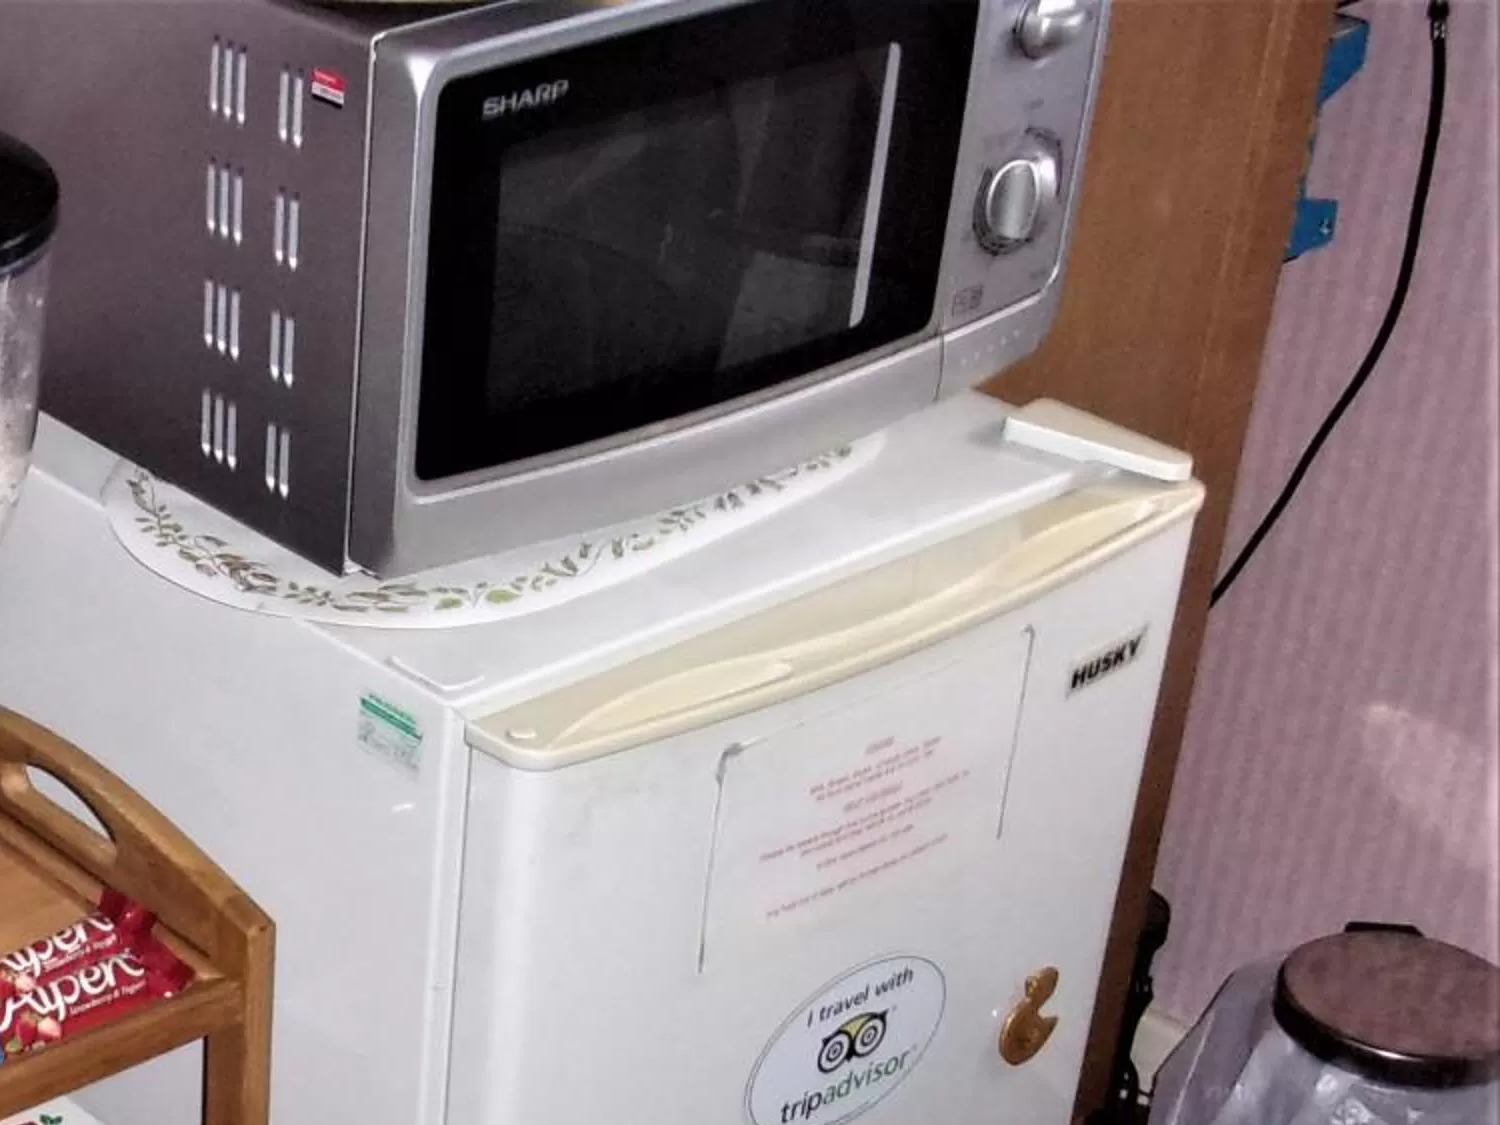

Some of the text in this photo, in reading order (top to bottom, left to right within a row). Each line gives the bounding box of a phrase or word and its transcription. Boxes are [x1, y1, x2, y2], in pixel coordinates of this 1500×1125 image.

[482, 79, 570, 121] SHARP
[1070, 633, 1144, 689] HUSKY
[807, 965, 914, 1029] I travel with
[780, 1048, 913, 1125] tripadvisor
